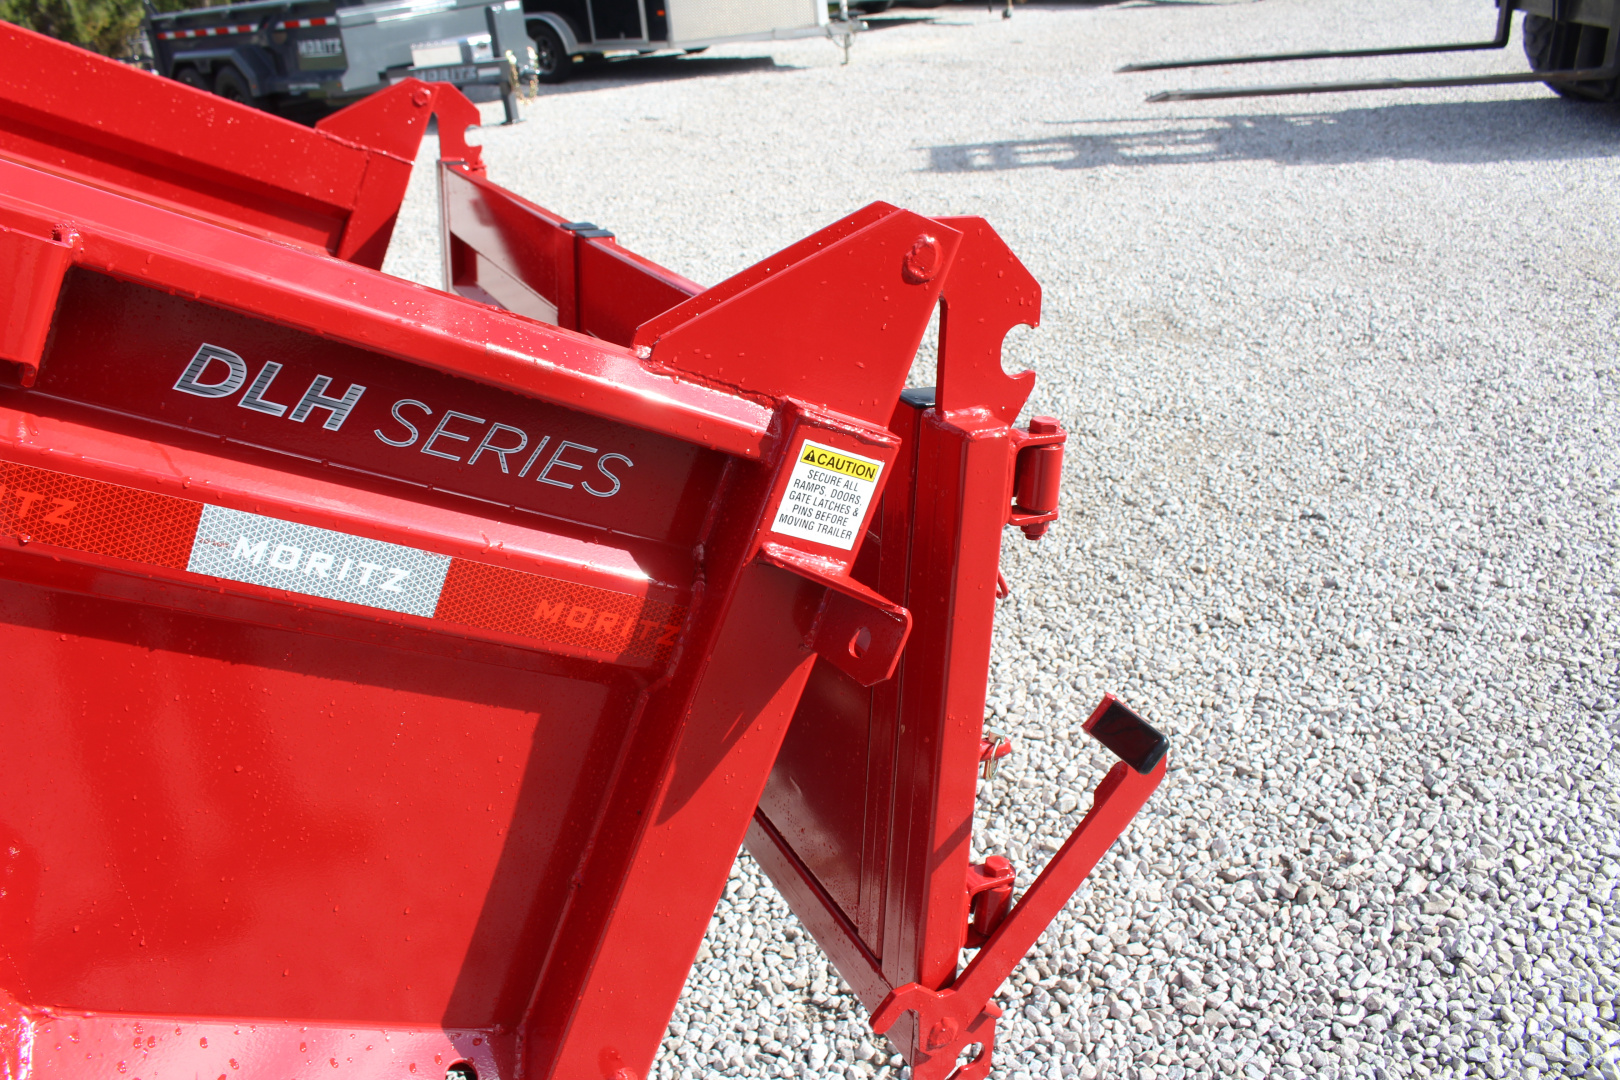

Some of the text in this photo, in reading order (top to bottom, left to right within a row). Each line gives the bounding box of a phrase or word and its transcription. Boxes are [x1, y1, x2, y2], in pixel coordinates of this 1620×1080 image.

[172, 342, 634, 497] DLH SERIES
[817, 453, 876, 479] CAUTION
[807, 469, 858, 492] SECURE ALL
[789, 490, 859, 517] GATE LATCHES &
[792, 504, 849, 527] PINS BEFORE
[778, 513, 853, 540] MOVING TRAILER
[232, 535, 410, 593] MORITZ
[532, 598, 681, 646] MORITZ
